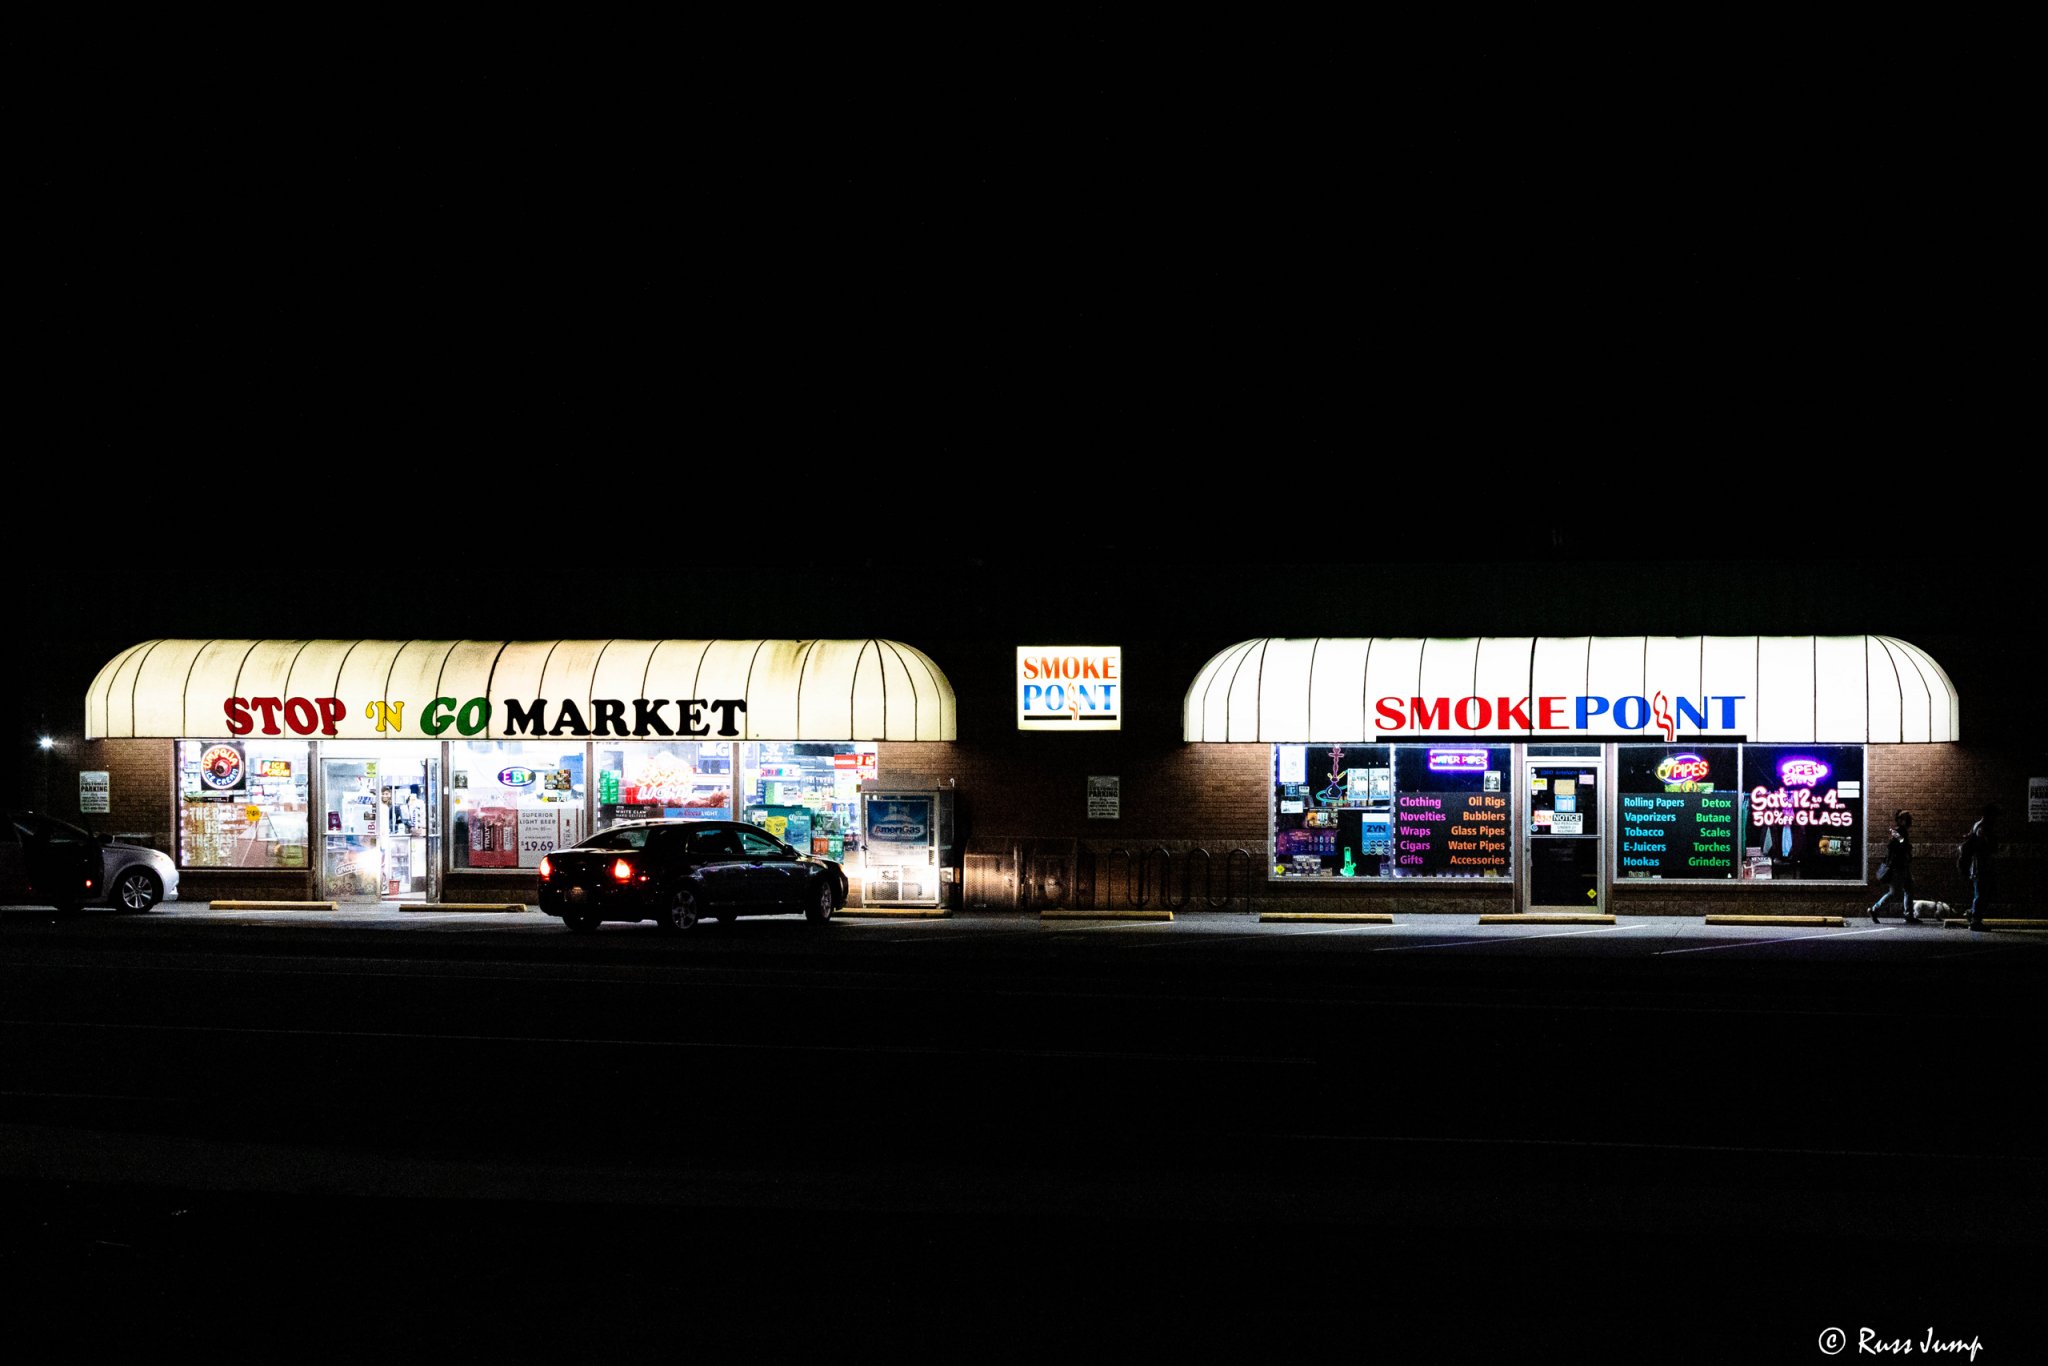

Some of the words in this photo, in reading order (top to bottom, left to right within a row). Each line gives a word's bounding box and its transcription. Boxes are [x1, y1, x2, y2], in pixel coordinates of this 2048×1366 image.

[1023, 656, 1118, 680] SMOKE
[1023, 682, 1117, 720] POINT
[224, 697, 346, 735] STOP
[420, 697, 492, 736] GO
[503, 699, 747, 736] MARKET
[1375, 696, 1570, 730] SMOKE
[1575, 691, 1745, 741] POINT
[271, 761, 286, 769] ICE
[1430, 755, 1460, 765] WATER
[1461, 755, 1488, 765] PIPES
[1673, 760, 1709, 778] PIPES
[1787, 763, 1822, 776] OPEN
[205, 770, 215, 783] ICE
[216, 768, 239, 785] CREAM
[502, 771, 532, 784] EBT
[1400, 797, 1442, 809] Clothing
[1468, 796, 1482, 807] Oil
[1484, 796, 1506, 809] Rigs
[1624, 797, 1654, 810] Rolling
[1656, 798, 1685, 810] Papers
[1701, 798, 1732, 808] Detox
[1793, 788, 1811, 808] 12
[1823, 788, 1839, 809] 4
[1400, 811, 1447, 822] Novelties
[1463, 811, 1506, 821] Bubblers
[1624, 812, 1677, 824] Vaporizers
[1696, 813, 1731, 823] Butane
[1795, 810, 1853, 827] GLASS
[874, 826, 921, 837] AmeriGas
[1366, 825, 1386, 833] ZYN
[1400, 827, 1431, 838] Wraps
[1451, 826, 1477, 836] Glass
[1480, 826, 1505, 838] Pipes
[1624, 827, 1665, 837] Tobacco
[1700, 828, 1731, 838] Scales
[521, 841, 554, 852] $19.69
[1400, 841, 1431, 852] Cigars
[1448, 841, 1477, 850] Water
[1480, 841, 1505, 853] Pipes
[1623, 842, 1667, 852] E-Juicers
[1693, 842, 1731, 852] Torches
[1400, 855, 1424, 865] Gifts
[1450, 855, 1505, 865] Accessories
[1623, 857, 1660, 867] Hookas
[1688, 857, 1731, 867] Grinders
